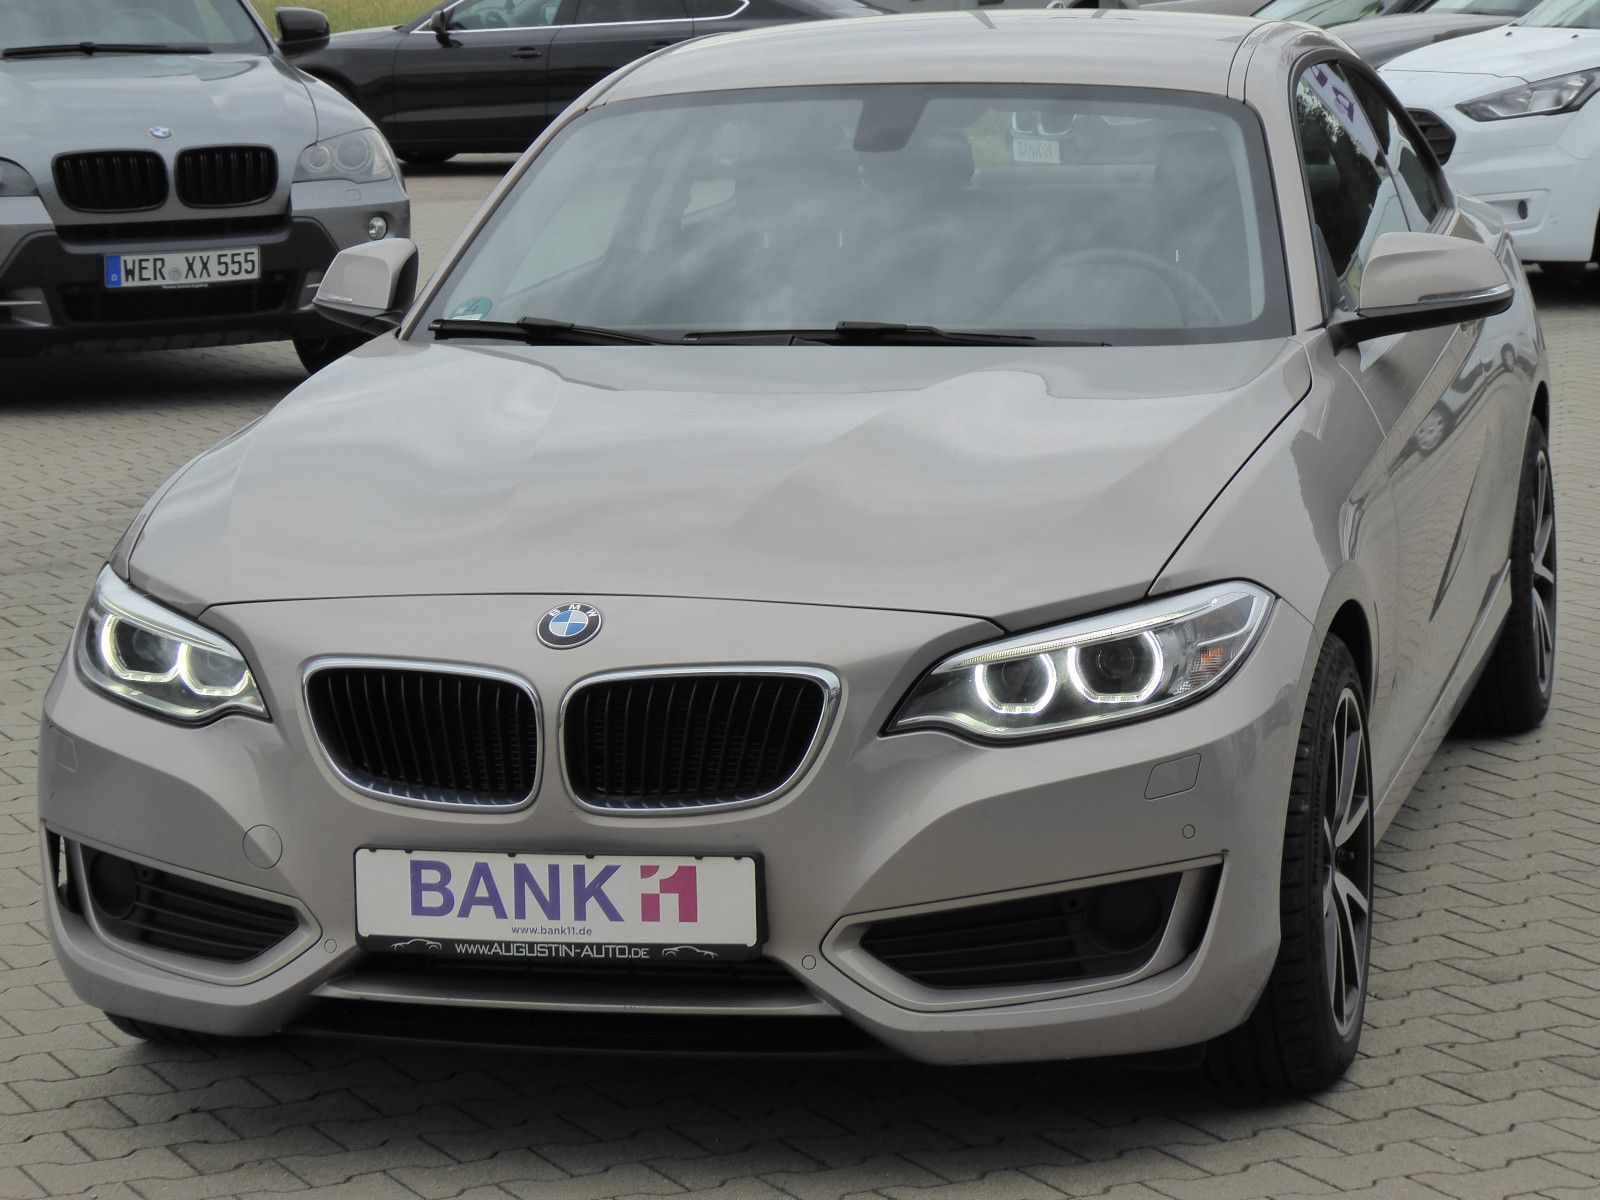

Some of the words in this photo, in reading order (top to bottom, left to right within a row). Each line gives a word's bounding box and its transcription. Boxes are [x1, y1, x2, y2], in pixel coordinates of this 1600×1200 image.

[123, 257, 166, 282] WER
[184, 255, 211, 279] XX
[217, 252, 256, 276] 555
[548, 604, 598, 617] BMW
[409, 859, 625, 922] BANK
[511, 925, 593, 936] www.bank11.de
